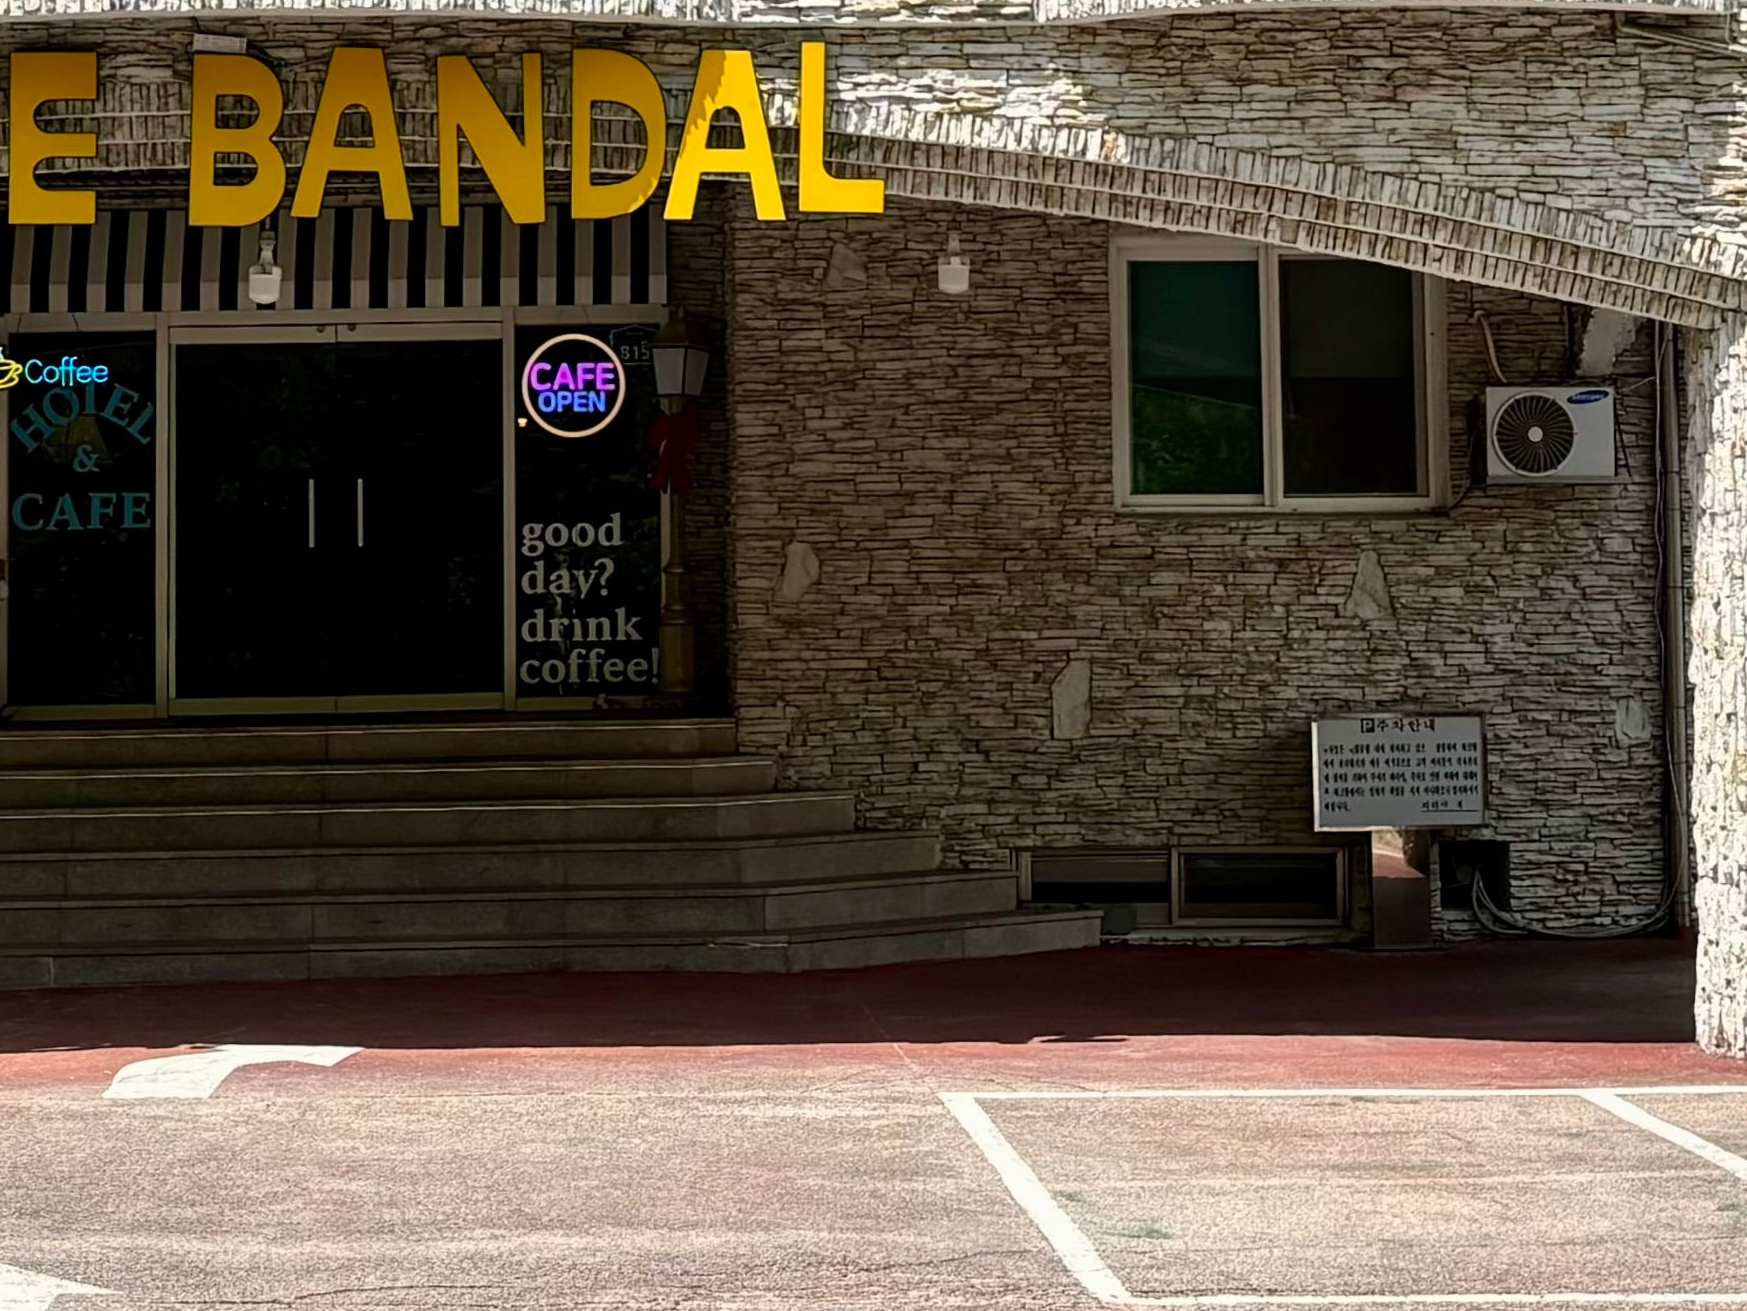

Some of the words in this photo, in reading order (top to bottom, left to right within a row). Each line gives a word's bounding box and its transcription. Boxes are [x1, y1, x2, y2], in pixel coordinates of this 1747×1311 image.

[188, 41, 887, 228] BANDAL
[24, 356, 109, 387] Coffee
[530, 362, 616, 391] CAFE
[538, 391, 607, 413] OPEN
[73, 444, 100, 473] &
[11, 492, 152, 531] CAFE
[520, 512, 625, 557] good
[521, 557, 615, 600] day?
[521, 606, 644, 643] drink
[519, 647, 660, 685] coffee!
